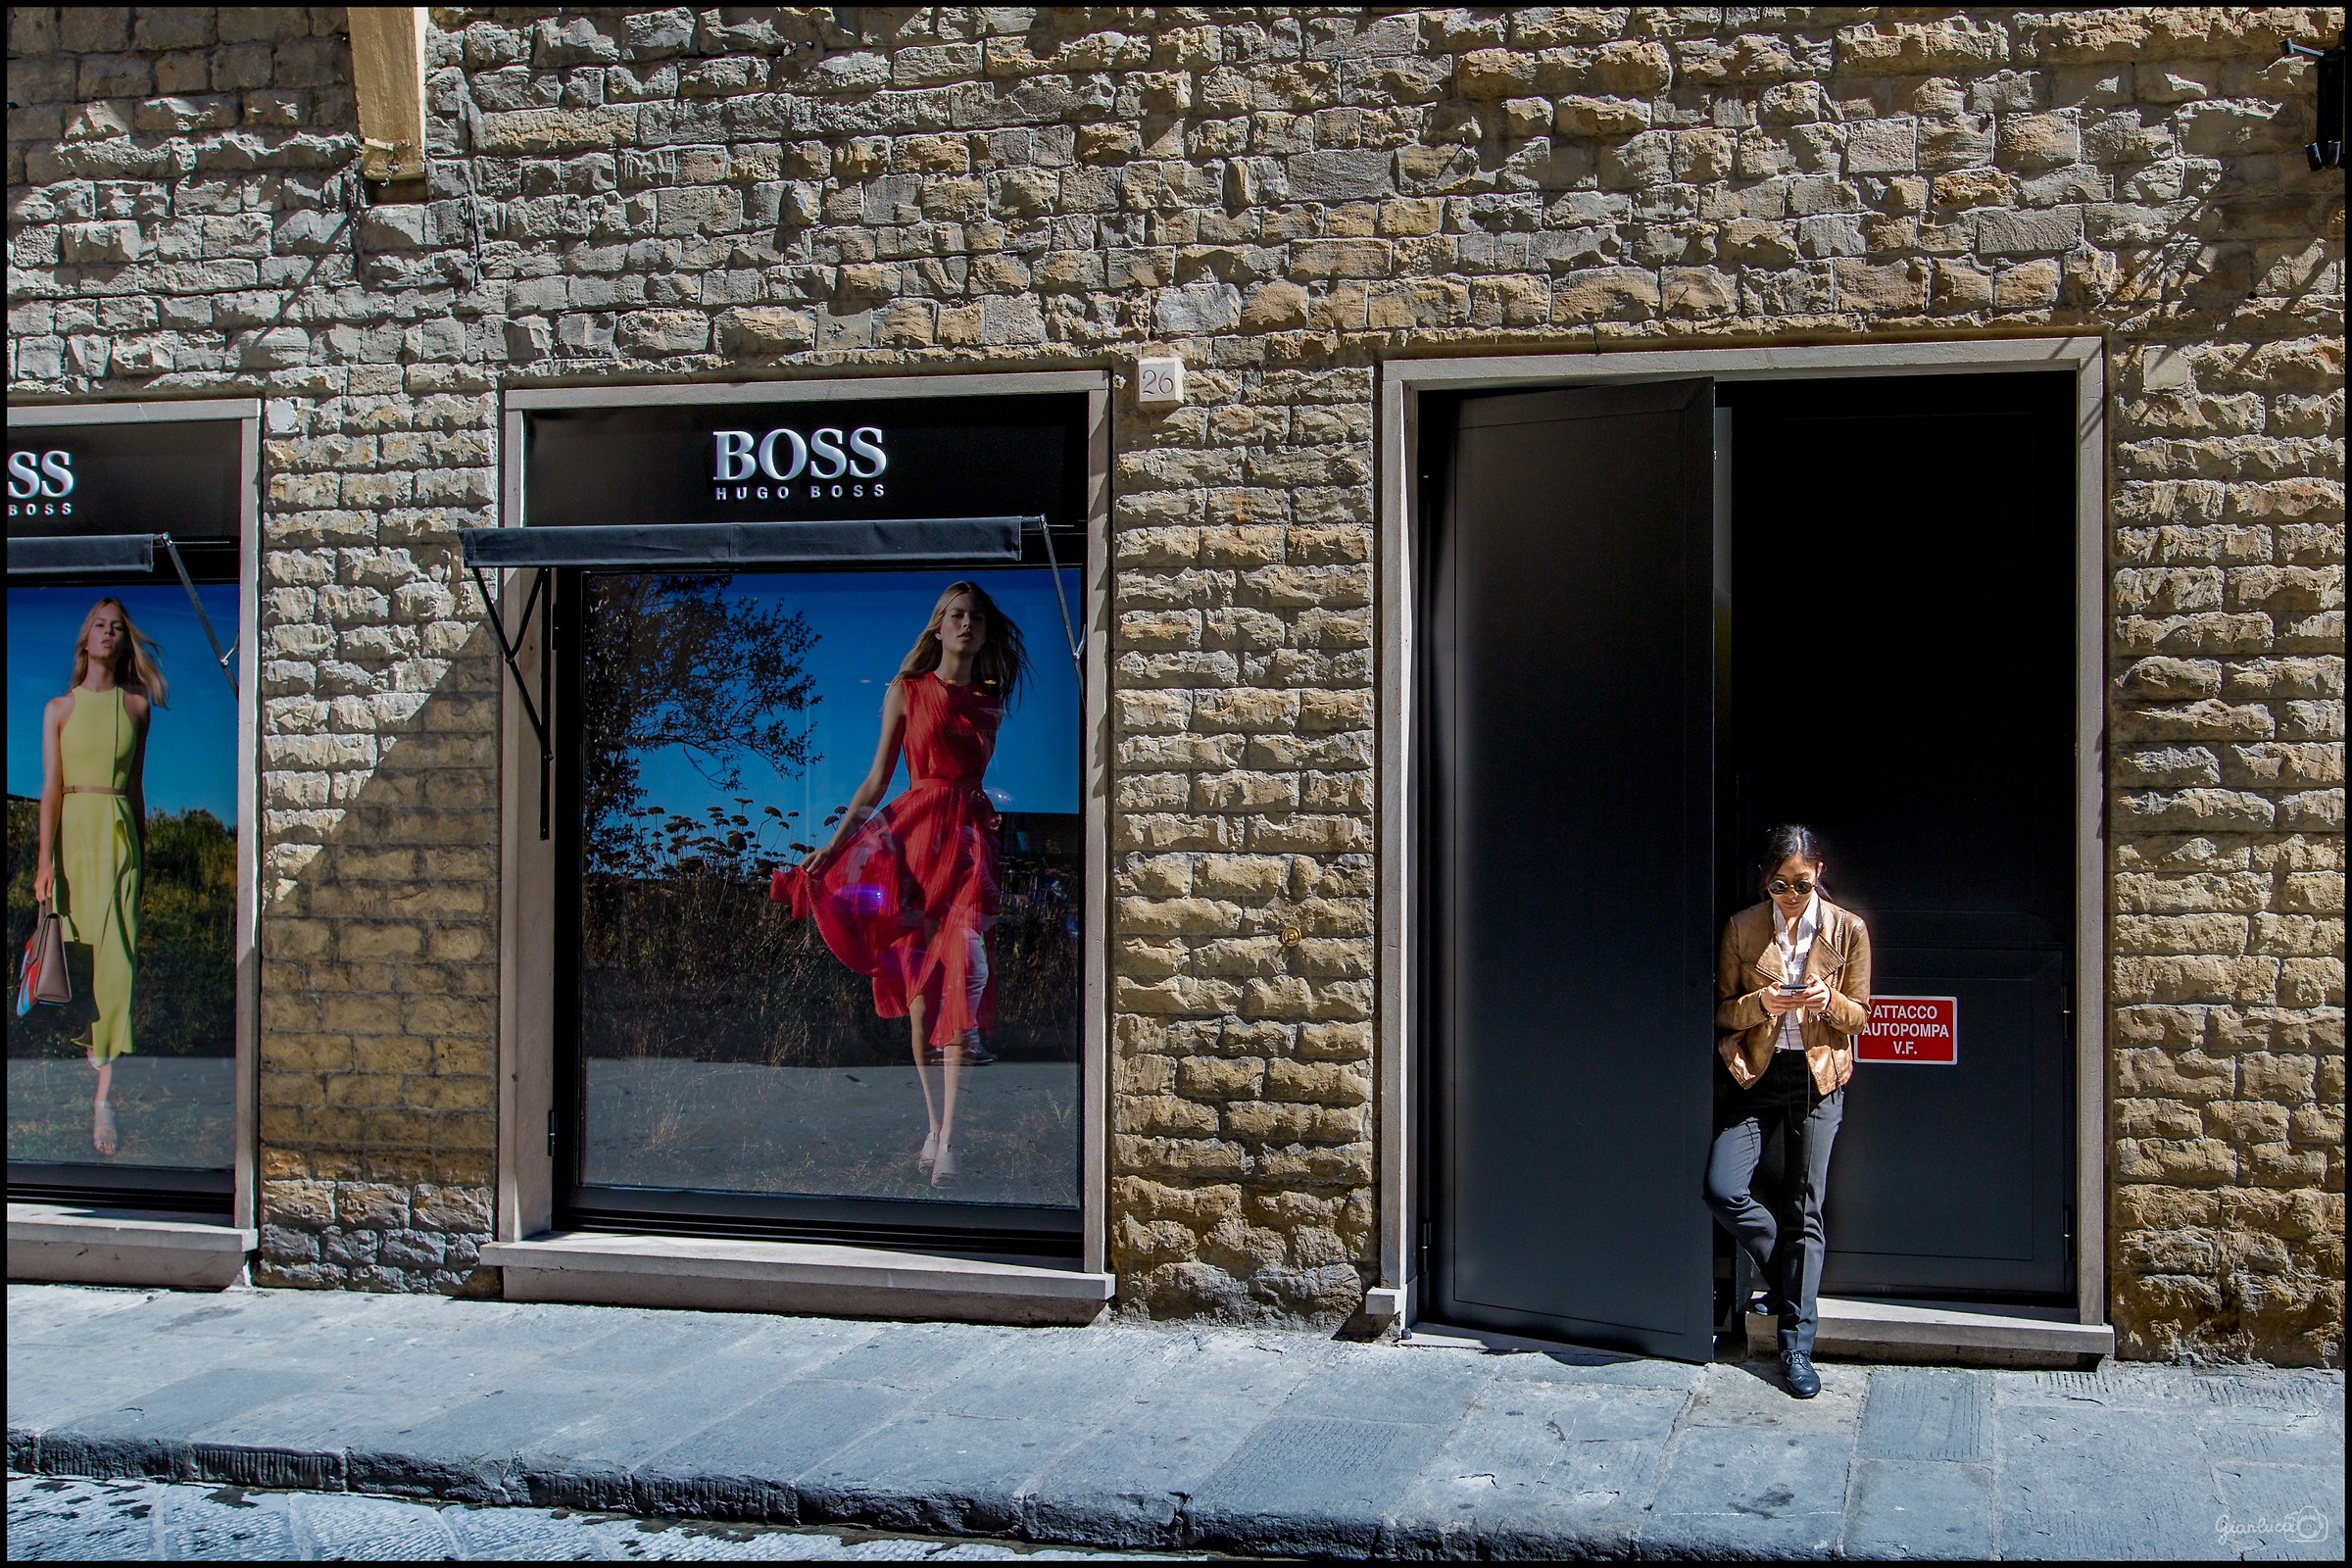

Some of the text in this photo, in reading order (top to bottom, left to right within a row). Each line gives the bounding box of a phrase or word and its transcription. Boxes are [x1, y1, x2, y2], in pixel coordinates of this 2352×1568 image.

[1142, 368, 1174, 395] 26
[712, 426, 887, 481] BOSS
[715, 484, 885, 501] HUGO BOSS
[8, 503, 72, 516] BOSS
[1873, 1004, 1937, 1019] ATTACCO
[1862, 1022, 1949, 1038] AUTOPOMPA
[1893, 1041, 1918, 1054] V.F.
